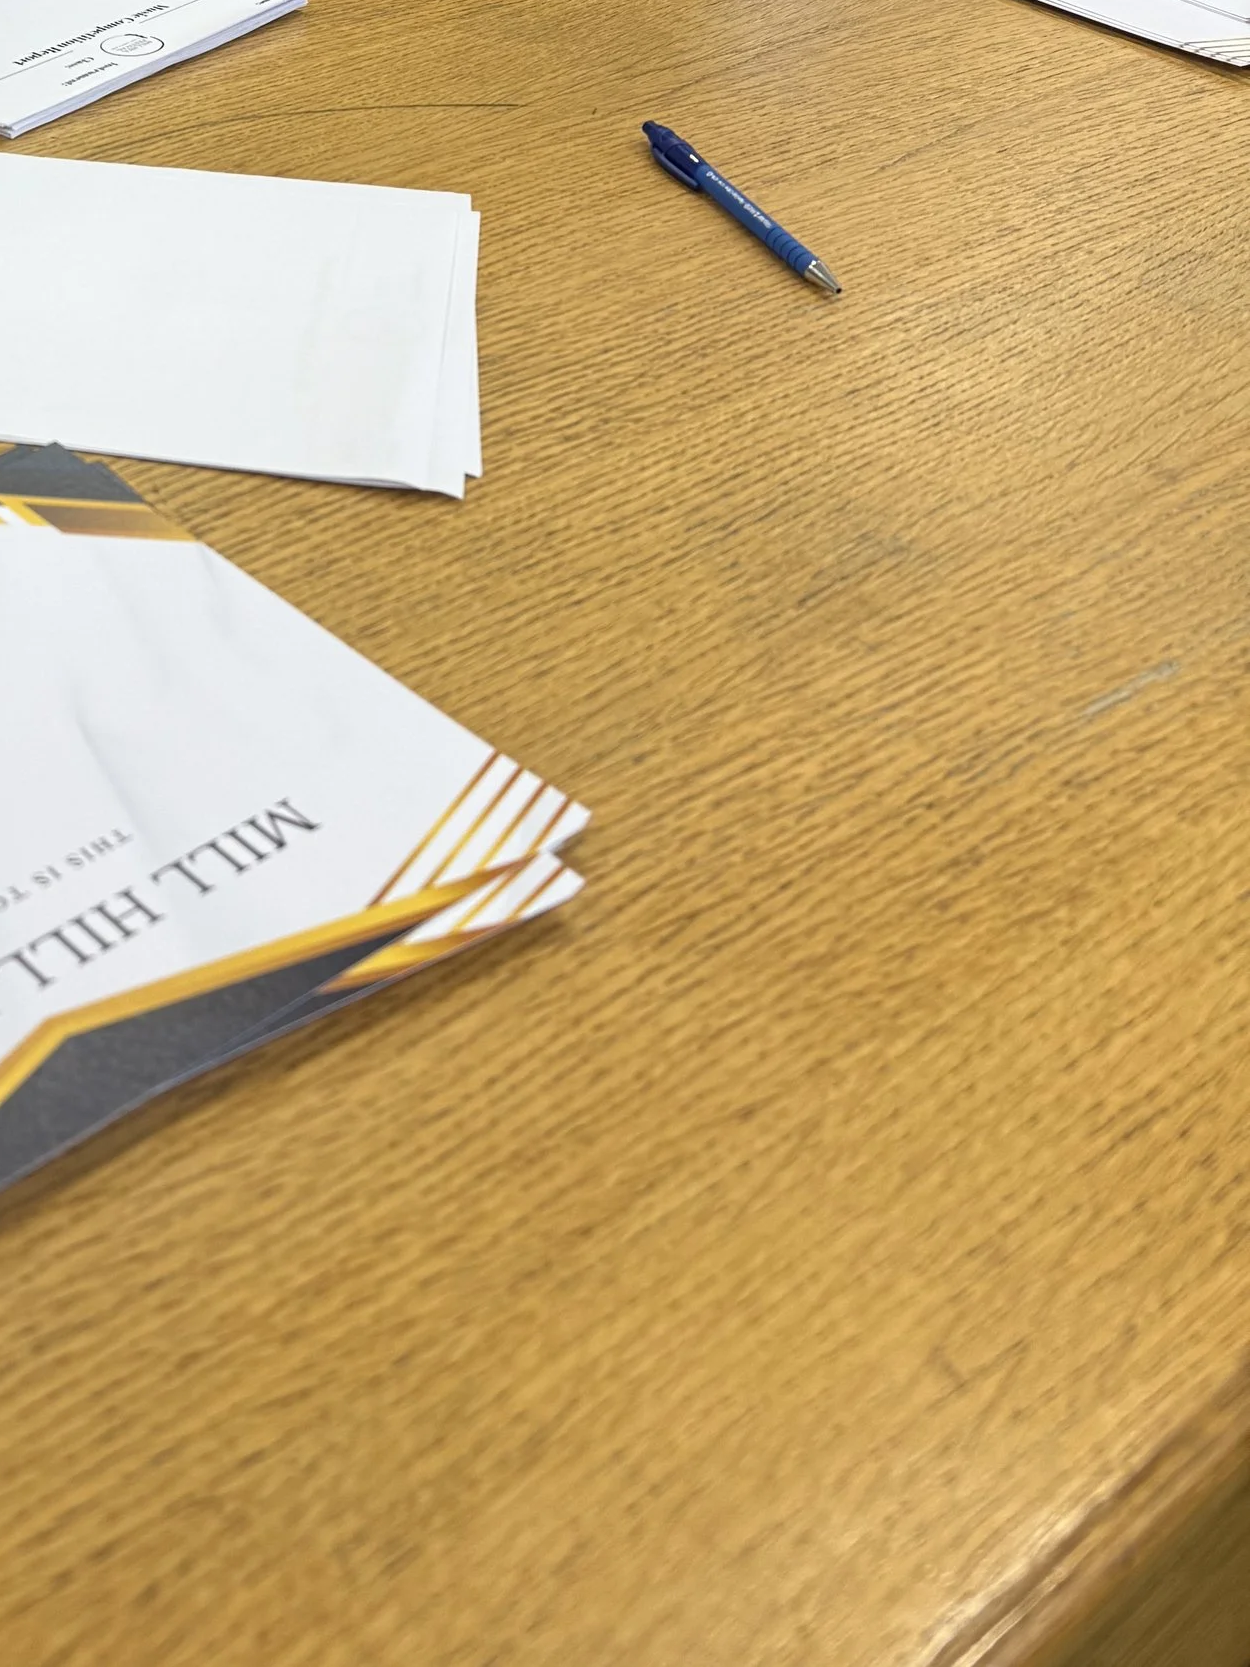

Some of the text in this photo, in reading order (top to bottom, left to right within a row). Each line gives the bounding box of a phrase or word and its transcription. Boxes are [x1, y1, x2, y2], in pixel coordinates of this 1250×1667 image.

[12, 4, 170, 67] Music Competition Report
[65, 827, 133, 869] THIS
[150, 797, 325, 899] MILL
[31, 863, 62, 891] IS
